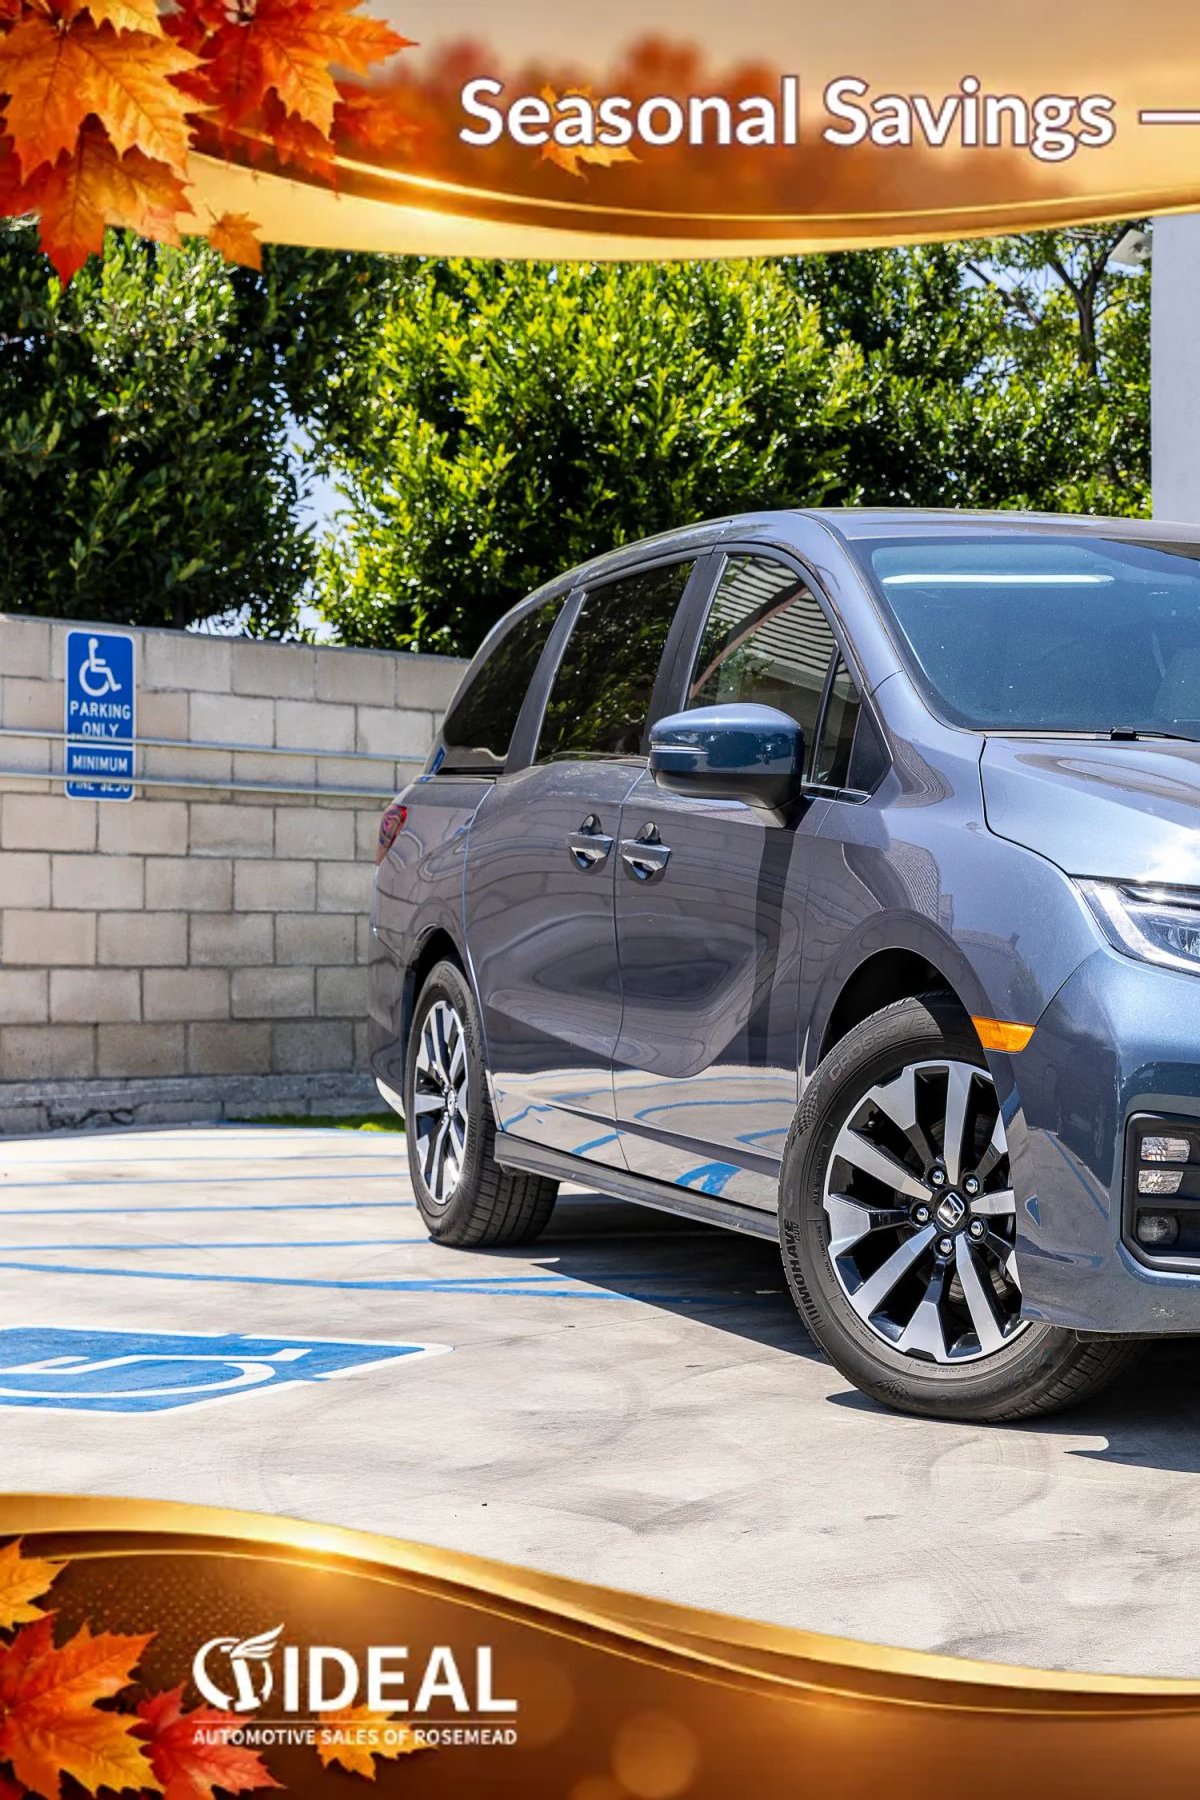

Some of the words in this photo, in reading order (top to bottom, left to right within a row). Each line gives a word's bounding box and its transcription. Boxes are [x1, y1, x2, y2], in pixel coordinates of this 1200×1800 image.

[70, 700, 131, 720] PARKING
[82, 722, 119, 737] ONLY
[73, 755, 127, 772] MINIMUM
[784, 1218, 813, 1306] MOHAVE
